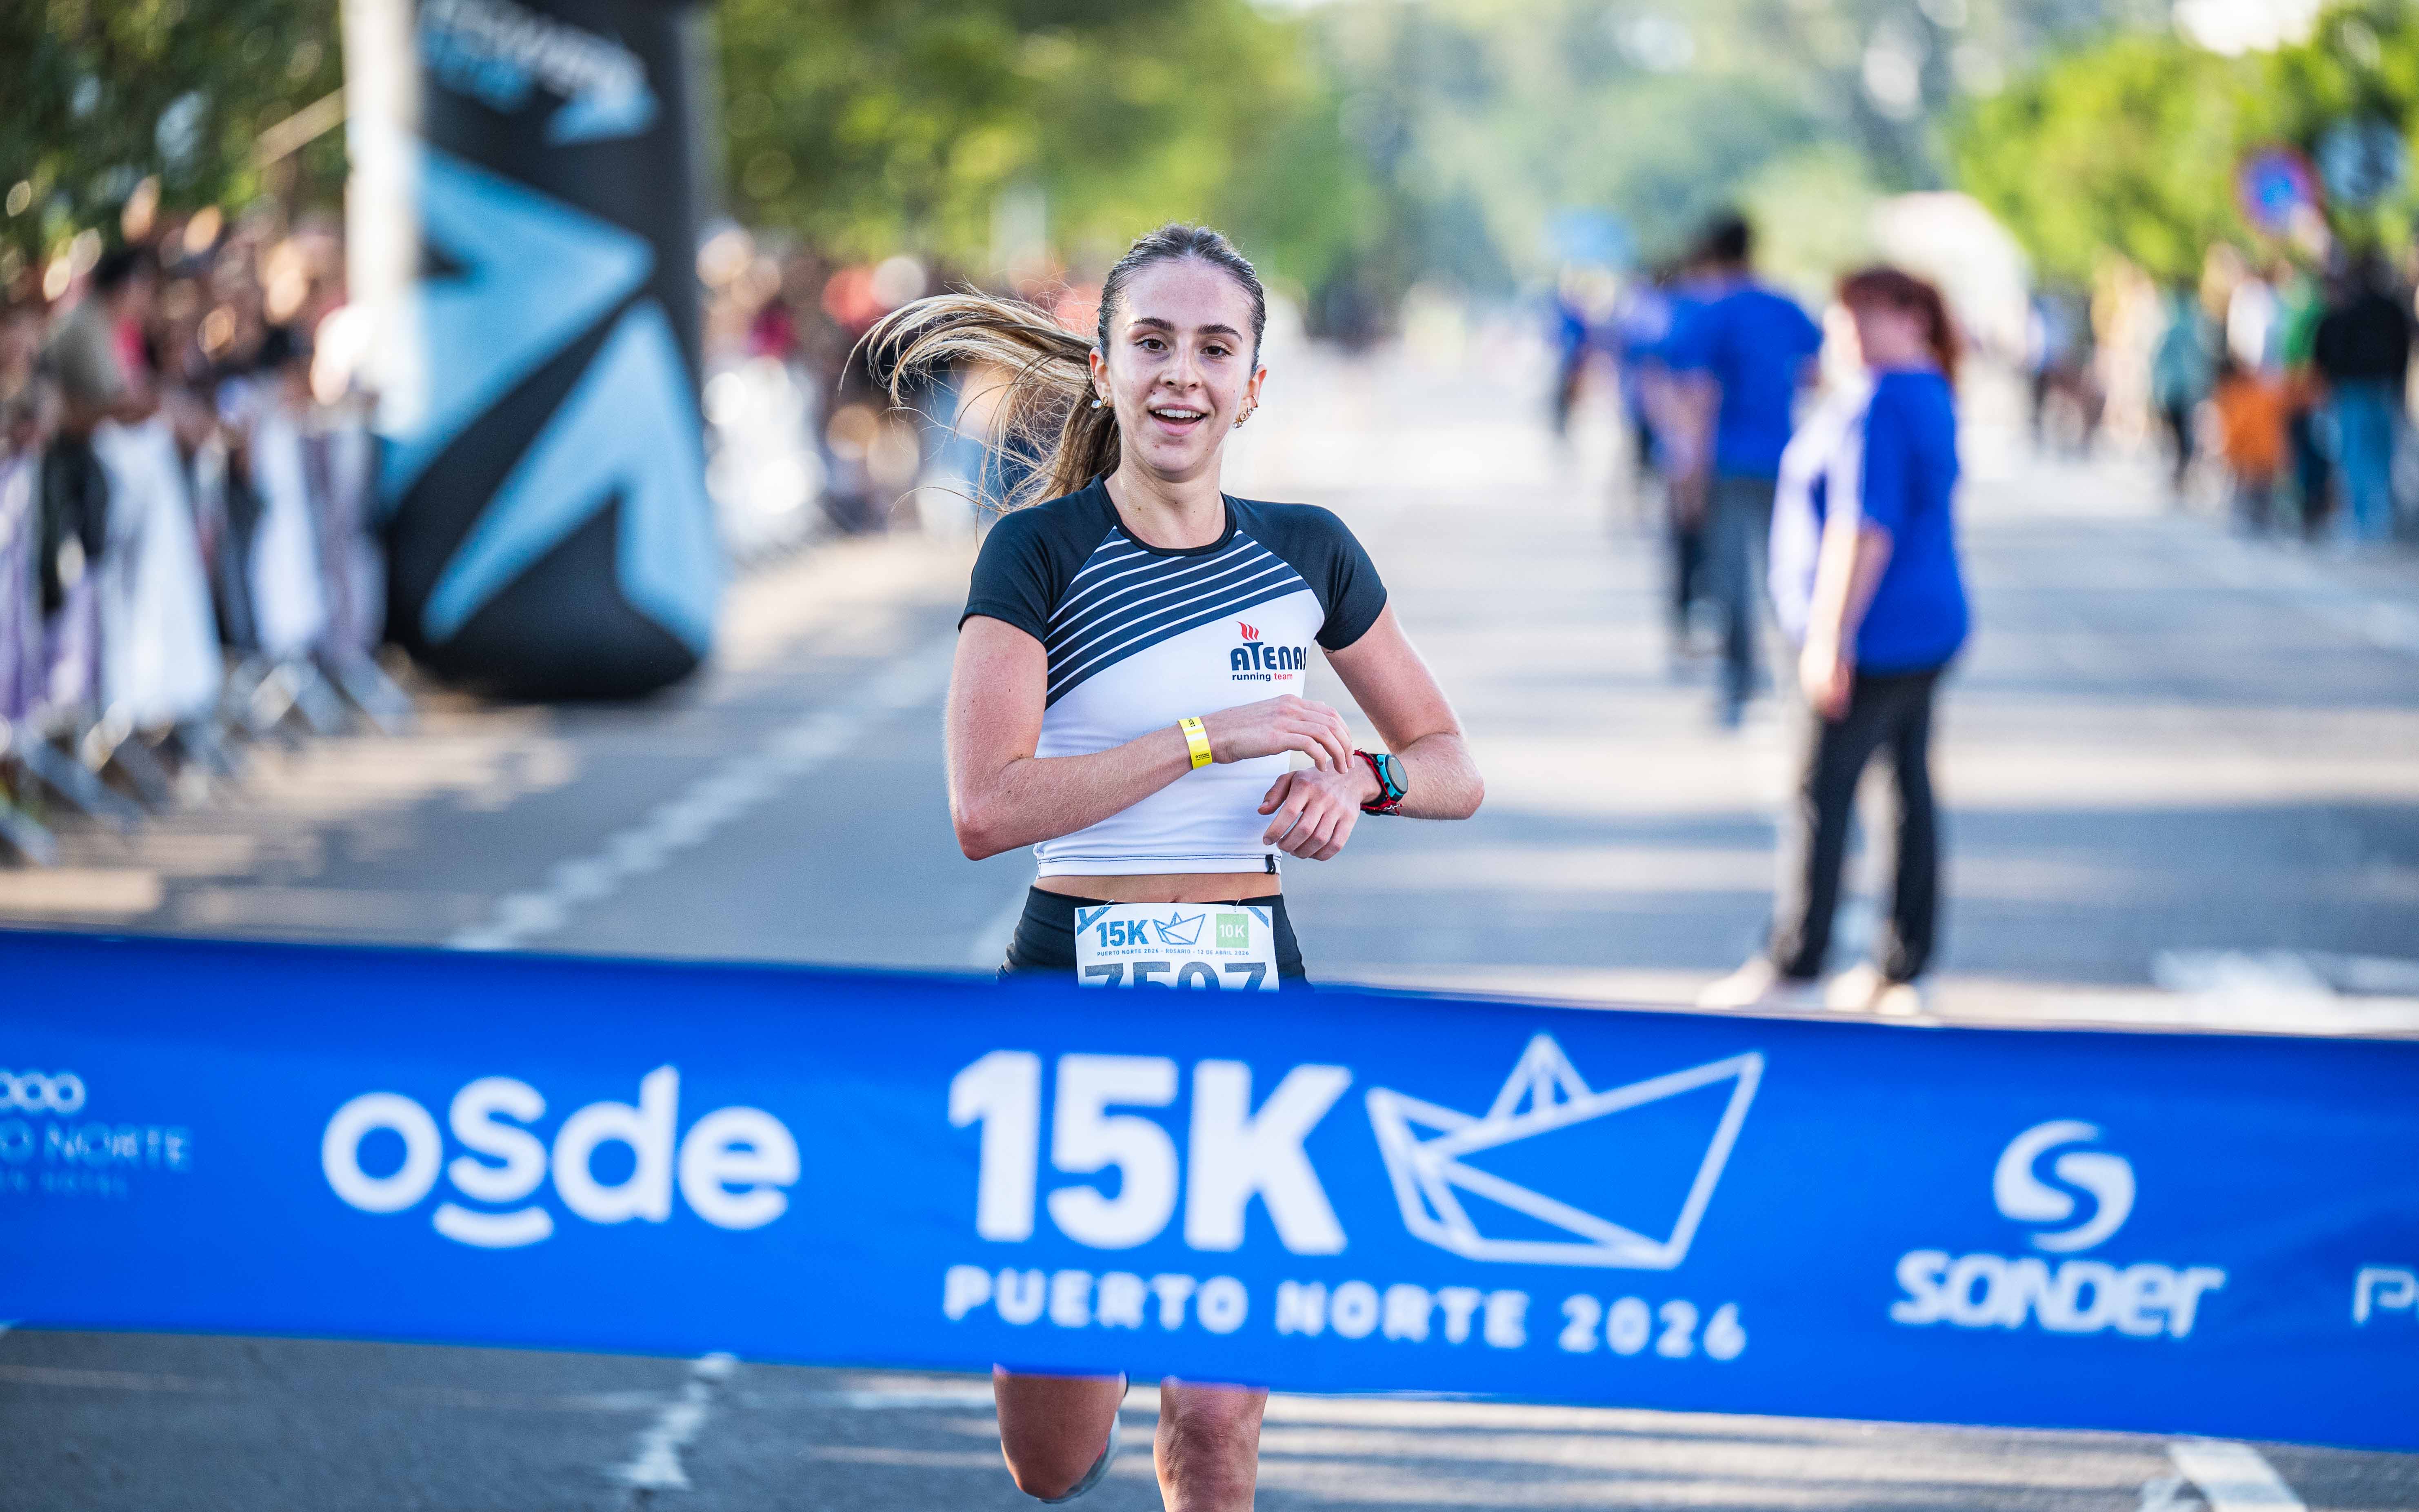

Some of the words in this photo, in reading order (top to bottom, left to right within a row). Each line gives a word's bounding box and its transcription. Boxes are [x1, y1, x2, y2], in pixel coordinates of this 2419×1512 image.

[1232, 673, 1271, 681] running
[1096, 920, 1149, 947] 15K
[1219, 925, 1245, 938] 10K
[322, 1065, 801, 1237] osde
[949, 1051, 1352, 1254] 15K
[944, 1265, 1248, 1333] PUERTO
[1275, 1280, 1528, 1348] NORTE
[1559, 1294, 1746, 1359] 2026
